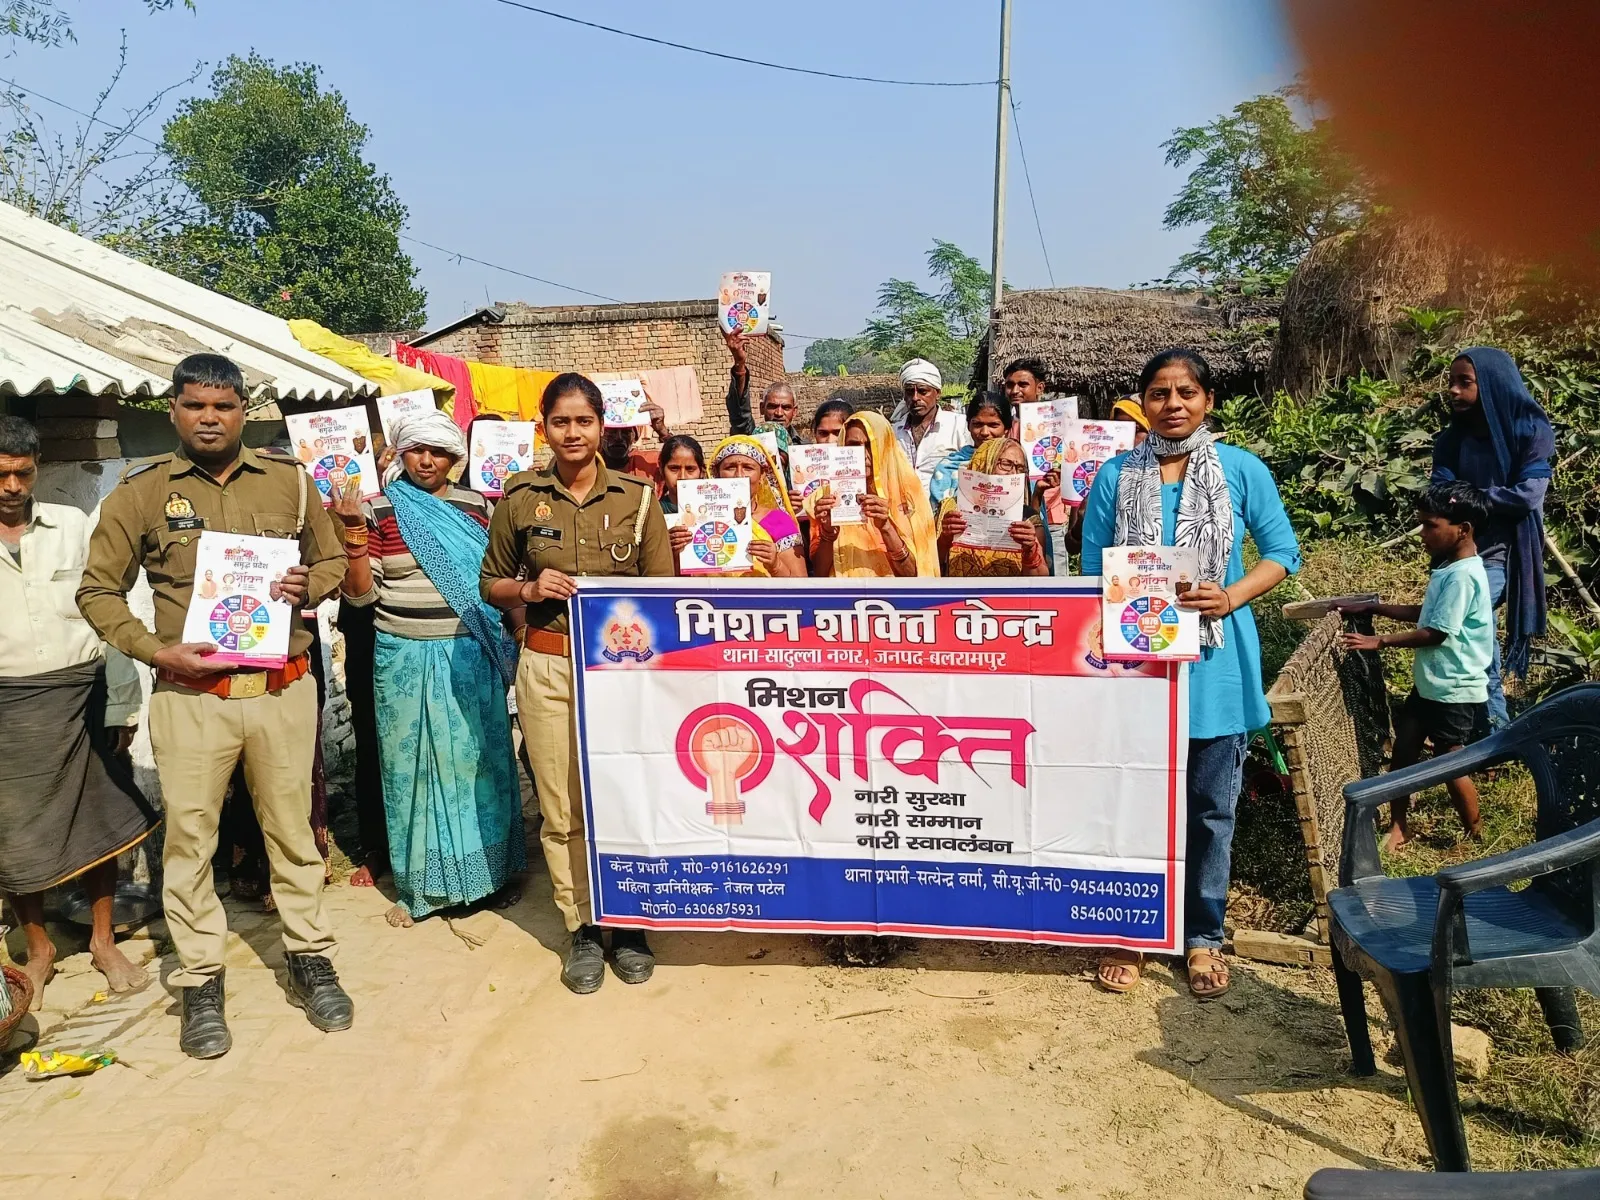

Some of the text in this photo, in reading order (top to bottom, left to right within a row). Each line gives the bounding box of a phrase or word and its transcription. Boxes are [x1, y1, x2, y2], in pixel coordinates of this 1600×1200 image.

[675, 598, 1059, 647] मिशन शक्ति केन्द्र
[723, 647, 823, 668] थाना-सादुल्ला
[873, 649, 1007, 672] जनपद-बलरामपुर
[745, 677, 848, 709] मिशन
[776, 678, 1037, 826] शक्ति
[854, 785, 967, 812] नारी सुरक्षा
[855, 809, 983, 830] नारी सम्मान
[856, 830, 1013, 854] नारी स्वावलंबन
[609, 856, 634, 874] केन्द्र
[636, 858, 669, 875] प्रभारी
[845, 868, 873, 883] थाना
[875, 865, 955, 889] प्रभारी-सत्येन्द्र
[616, 877, 650, 895] महिला
[723, 877, 753, 895] तेजल
[757, 879, 786, 896] पटेल
[1071, 905, 1159, 925] 8546001727
